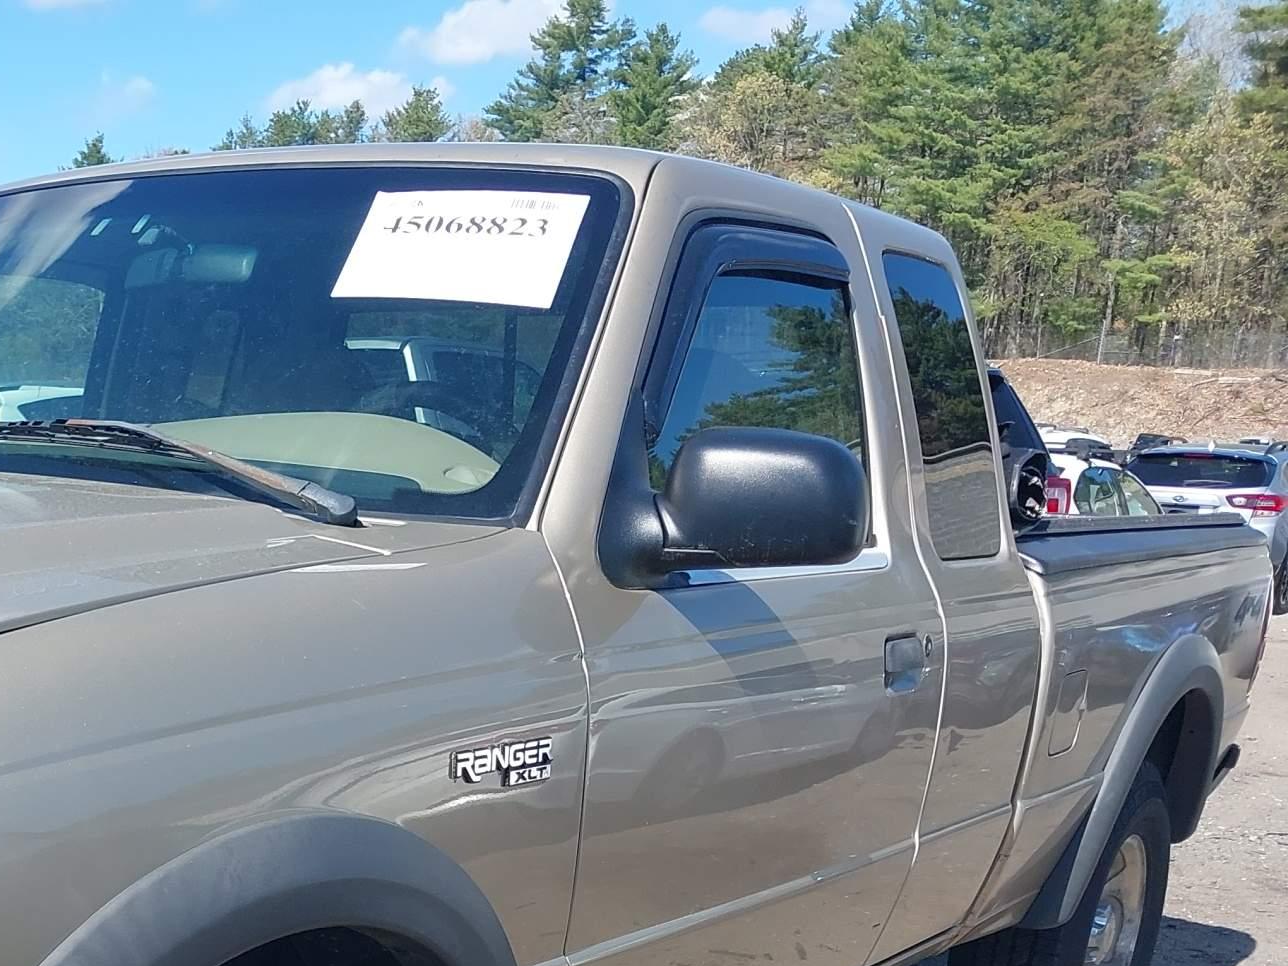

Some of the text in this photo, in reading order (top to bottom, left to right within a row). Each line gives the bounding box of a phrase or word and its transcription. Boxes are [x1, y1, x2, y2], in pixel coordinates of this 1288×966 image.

[383, 214, 550, 238] 45068823
[455, 737, 553, 783] RANGER
[514, 766, 549, 783] XLT
